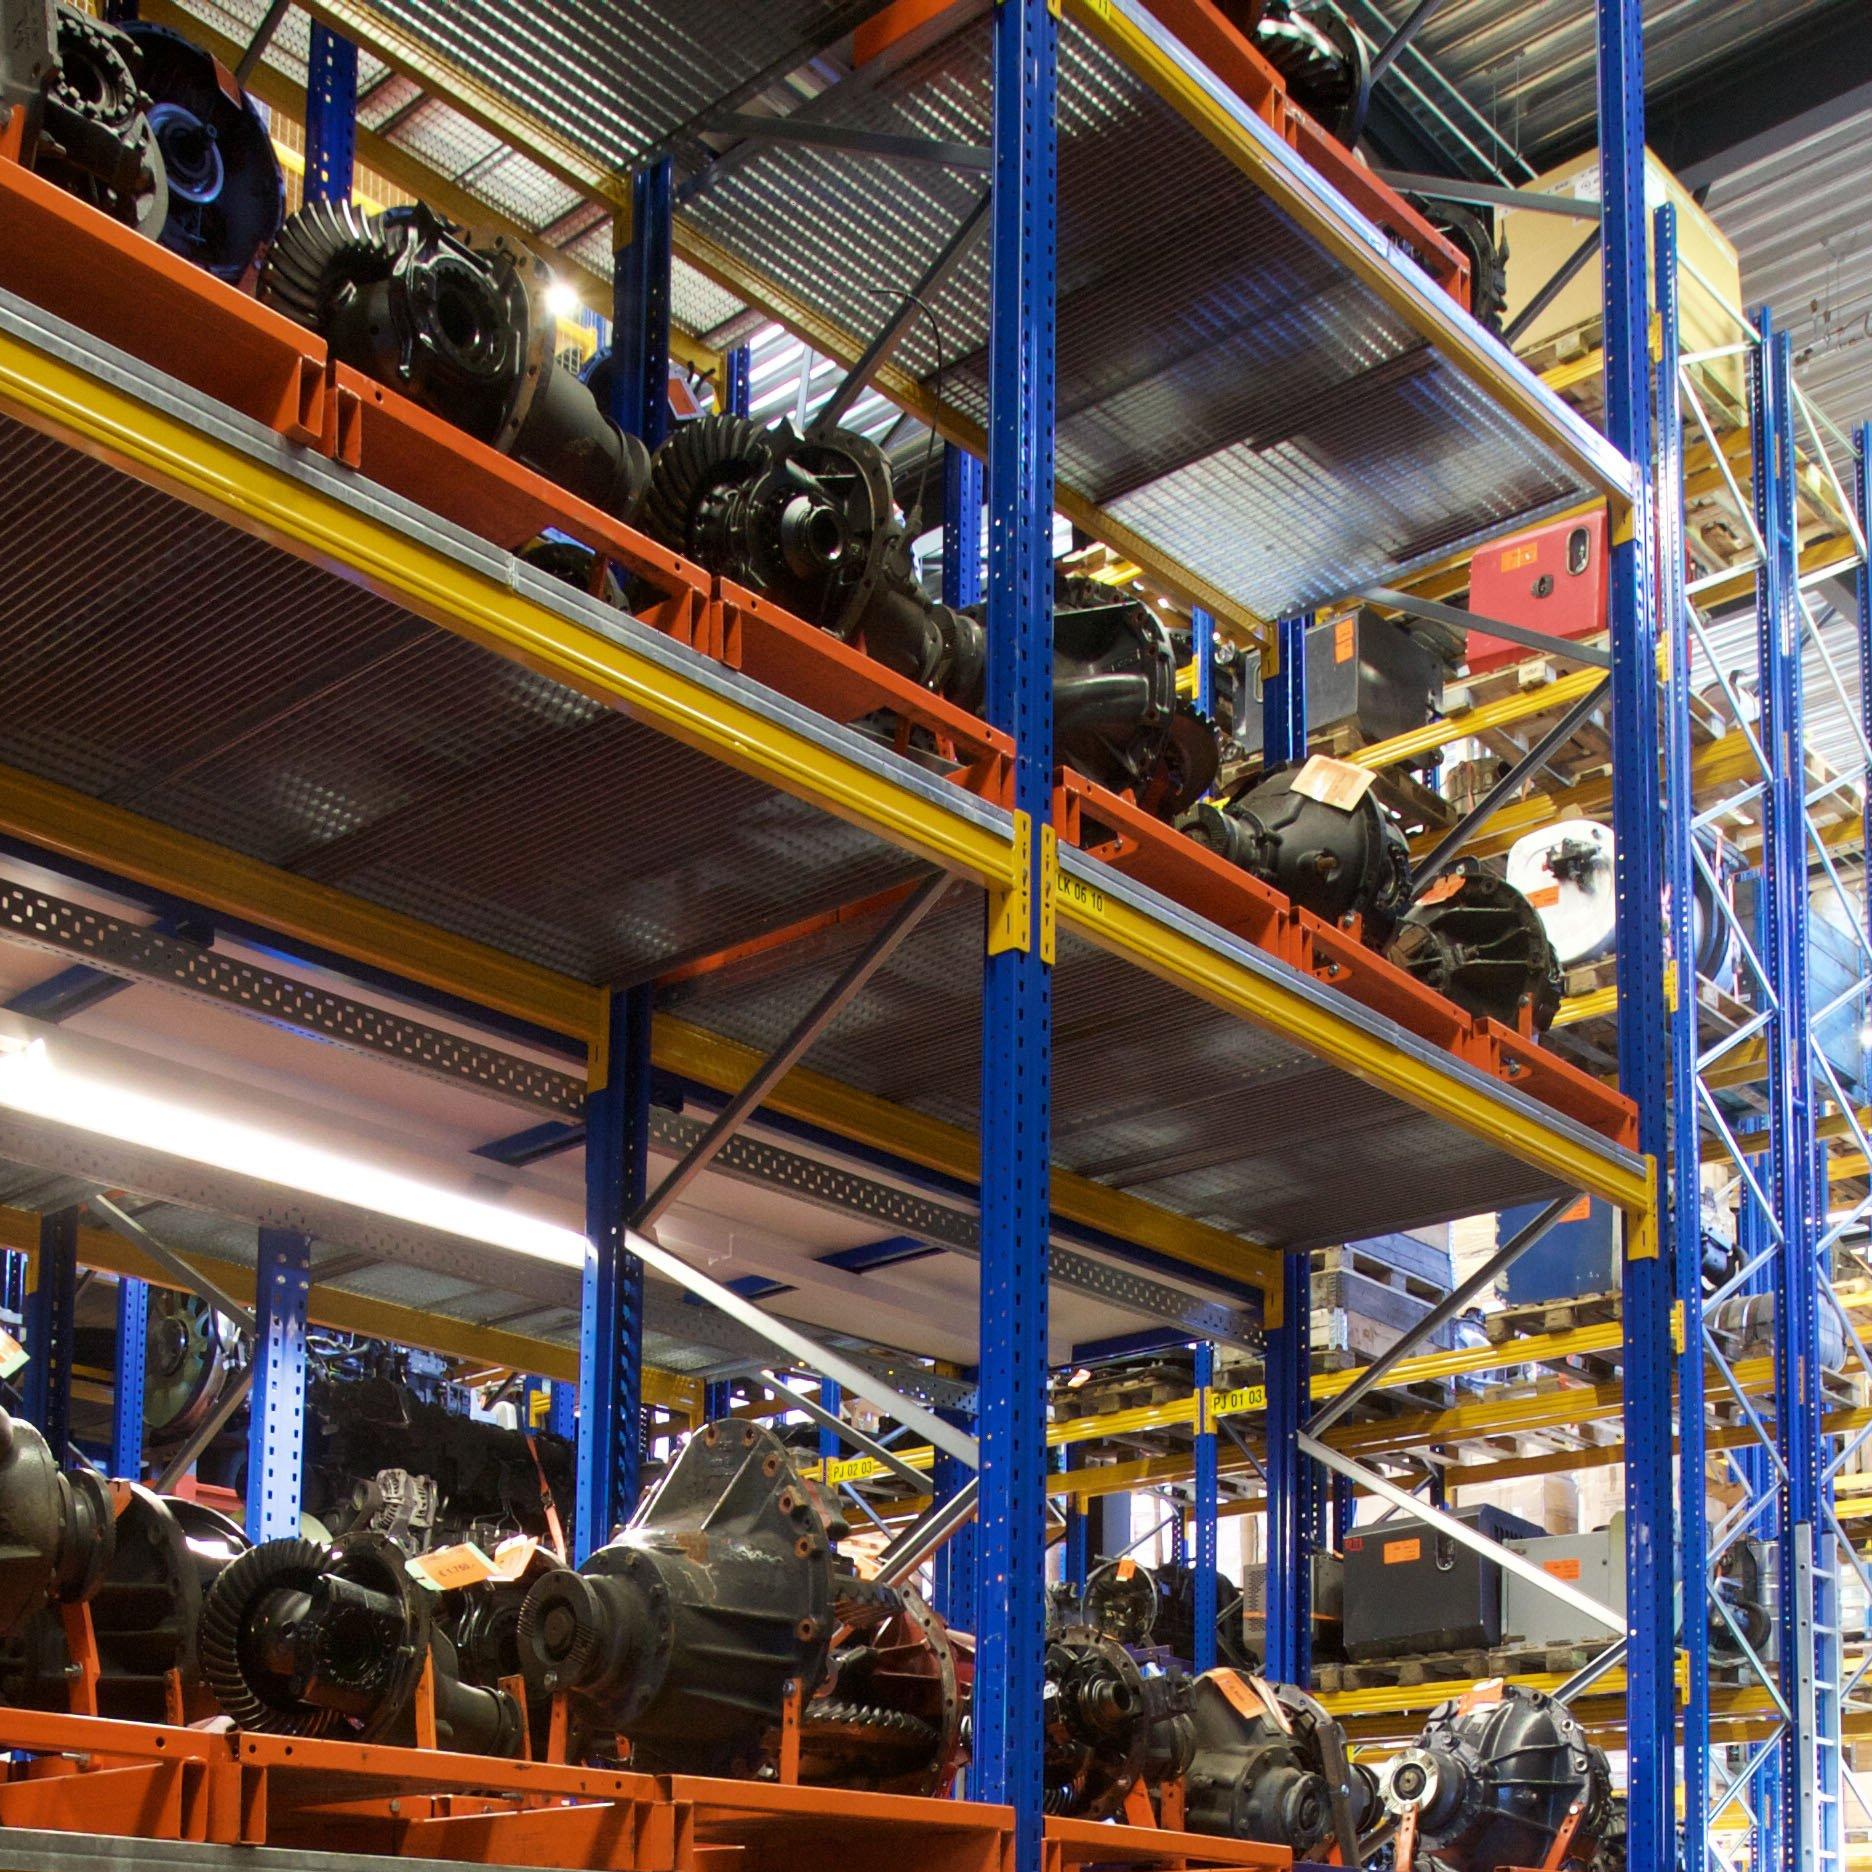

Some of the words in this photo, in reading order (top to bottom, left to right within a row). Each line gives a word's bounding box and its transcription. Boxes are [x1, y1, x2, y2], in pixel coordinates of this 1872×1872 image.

[1057, 873, 1071, 896] LK
[1074, 882, 1087, 904] 06
[1091, 891, 1103, 913] 10
[1213, 1394, 1227, 1411] PJ
[1231, 1393, 1244, 1409] 01
[1248, 1389, 1263, 1405] 03
[833, 1465, 845, 1480] PJ
[847, 1462, 859, 1477] 02
[861, 1460, 873, 1475] 03
